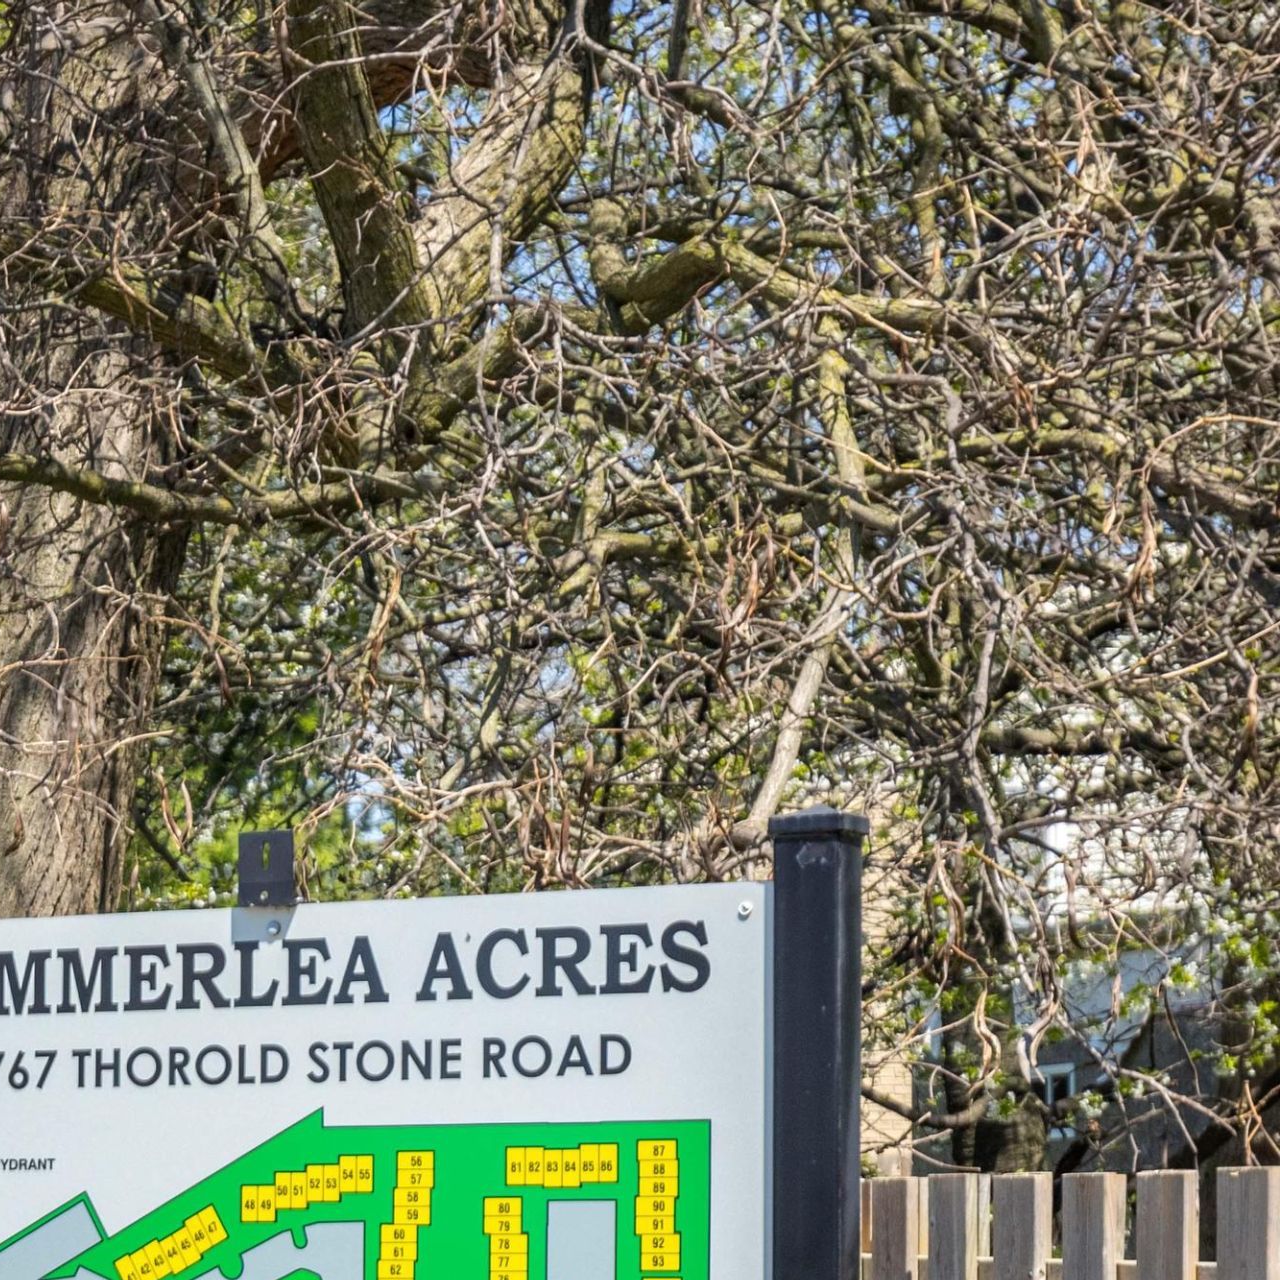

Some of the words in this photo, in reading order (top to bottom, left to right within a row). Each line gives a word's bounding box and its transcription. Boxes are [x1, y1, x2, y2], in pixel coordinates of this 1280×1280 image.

[415, 918, 713, 1003] ACRES
[71, 1042, 290, 1089] THOROLD
[306, 1037, 464, 1084] STONE
[481, 1033, 634, 1080] ROAD
[653, 1145, 665, 1157] 87
[410, 1156, 422, 1167] 56
[510, 1160, 522, 1173] 81
[528, 1160, 540, 1173] 82
[546, 1160, 558, 1173] 83
[564, 1160, 576, 1172] 84
[582, 1160, 594, 1172] 85
[600, 1159, 612, 1172] 86
[653, 1163, 665, 1176] 88
[410, 1173, 422, 1185] 57
[244, 1199, 256, 1210] 48
[260, 1198, 272, 1210] 49
[276, 1185, 288, 1197] 50
[292, 1185, 304, 1196] 51
[309, 1178, 321, 1190] 52
[325, 1178, 337, 1189] 53
[342, 1168, 354, 1180] 54
[359, 1168, 370, 1180] 55
[653, 1181, 665, 1194] 89
[407, 1191, 419, 1203] 58
[653, 1200, 665, 1212] 90
[407, 1209, 418, 1221] 59
[498, 1220, 510, 1232] 79
[652, 1218, 664, 1231] 91
[498, 1238, 510, 1250] 78
[652, 1237, 664, 1249] 92
[393, 1246, 404, 1258] 61
[498, 1256, 510, 1268] 77
[652, 1255, 664, 1267] 93
[390, 1264, 402, 1276] 62
